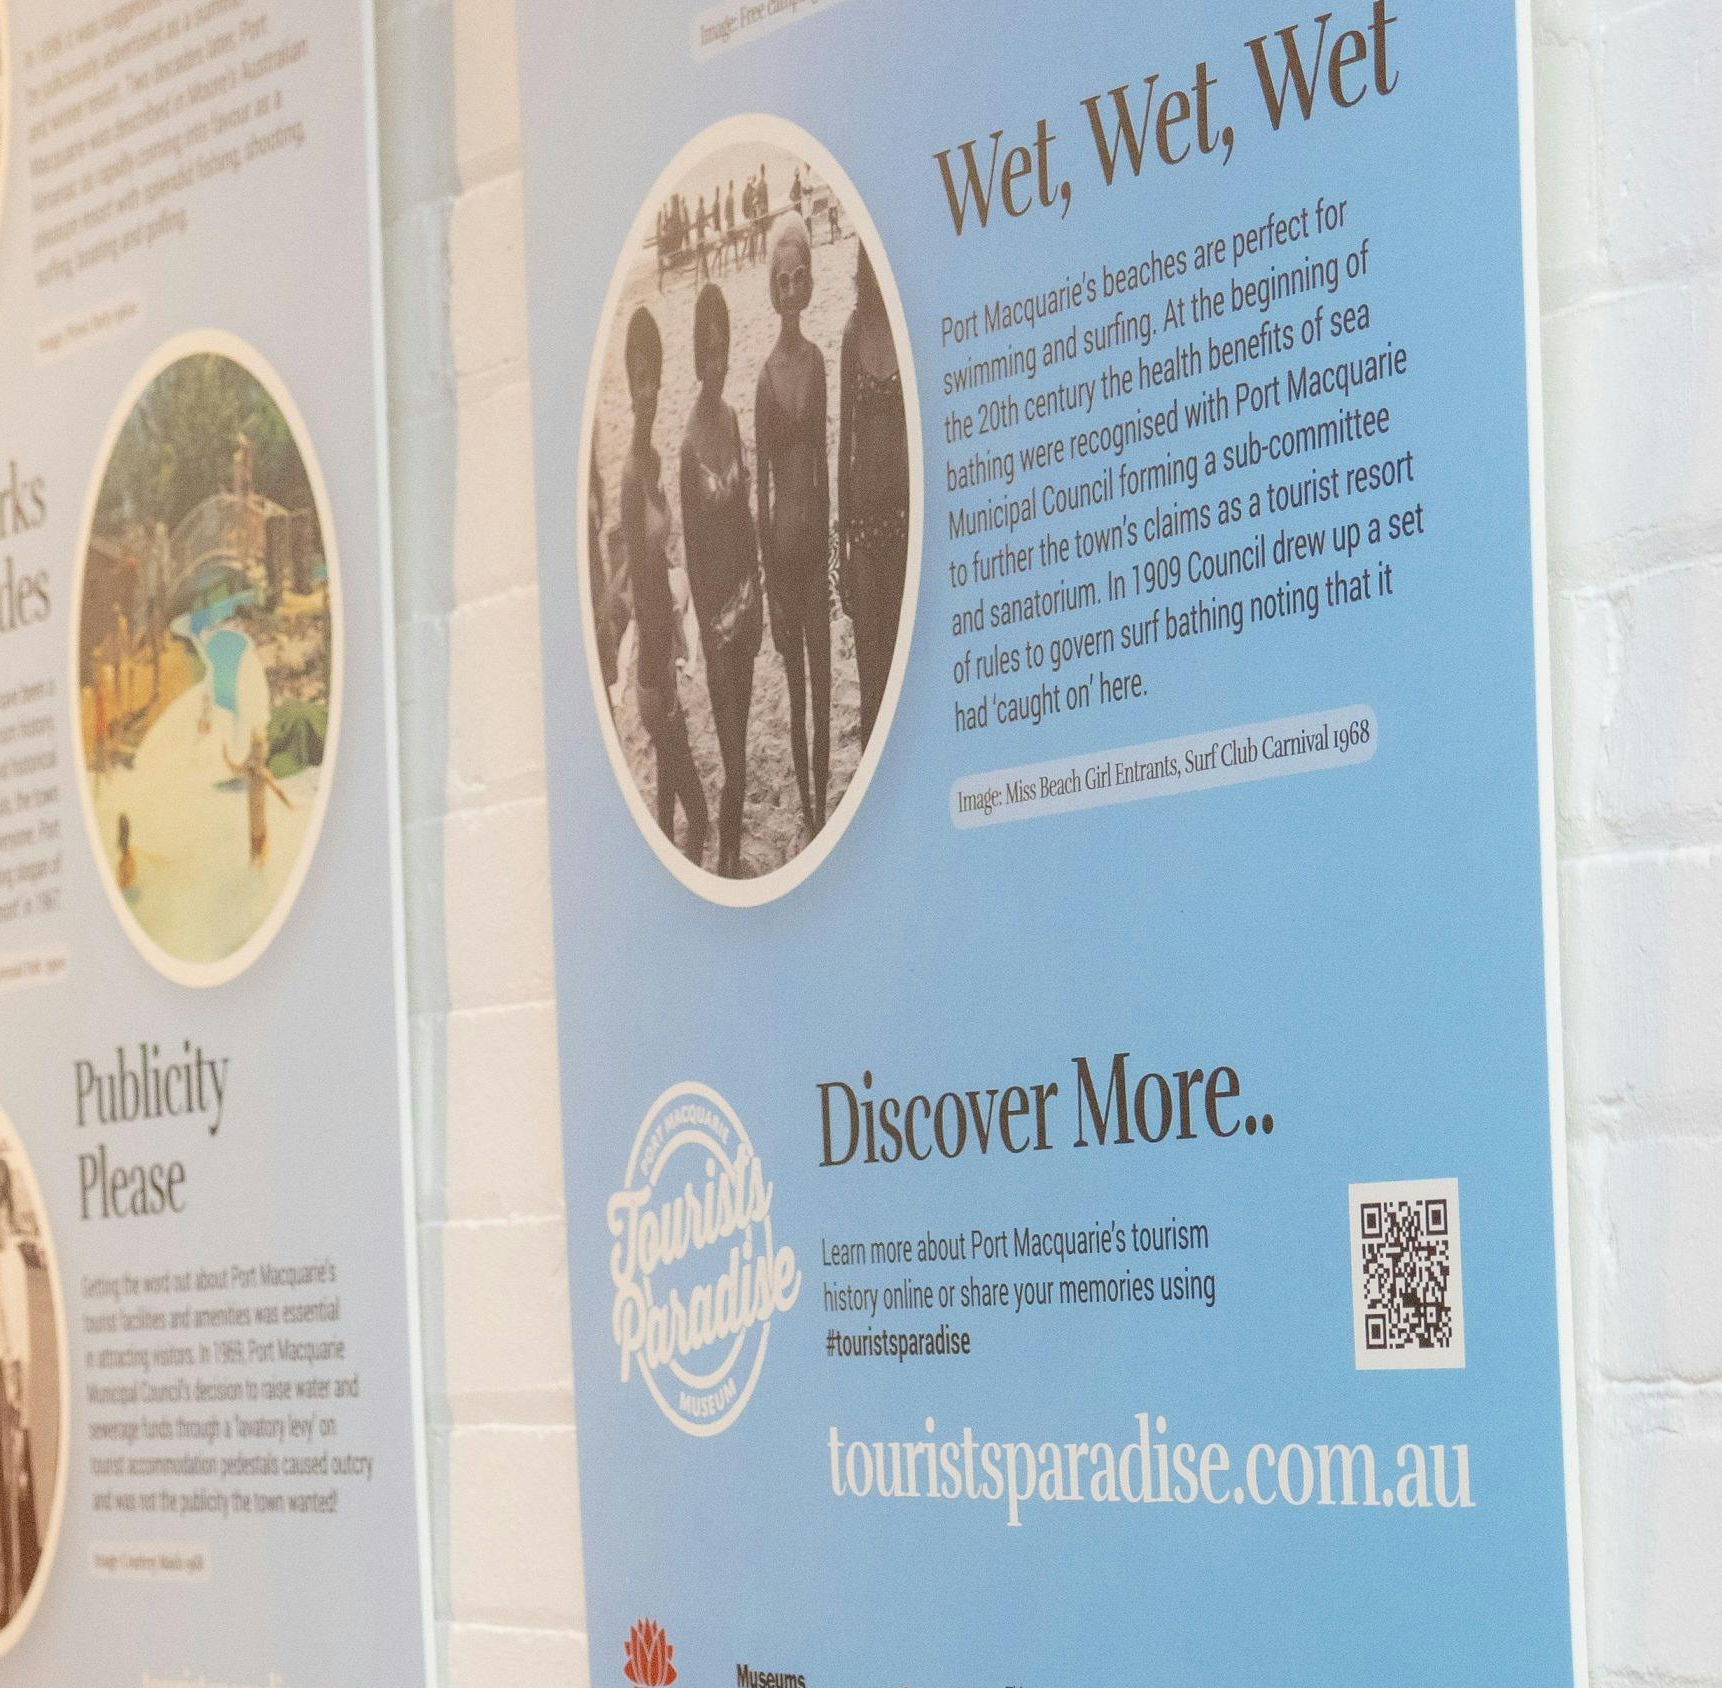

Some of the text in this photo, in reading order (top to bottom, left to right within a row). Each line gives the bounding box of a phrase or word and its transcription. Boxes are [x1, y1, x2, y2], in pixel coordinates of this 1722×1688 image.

[933, 0, 1400, 237] Wet, Wet, Wet
[942, 313, 978, 344] Port
[1103, 251, 1187, 297] beaches
[1194, 239, 1225, 270] are
[1233, 208, 1309, 267] perfect
[1315, 197, 1347, 233] for
[944, 238, 1369, 395] swimming and surfing. At the beginning of
[945, 304, 1369, 443] the 20th century the health benefits of sea
[947, 342, 1407, 491] bathing were recognised with Port Macquarie
[949, 408, 1389, 539] Municipal Council forming a sub-committee
[953, 504, 1424, 636] and sanatorium. In 1909 Council drew up a set
[955, 696, 987, 732] had
[1100, 671, 1147, 703] here.
[959, 719, 1370, 815] Image: Miss Beach Girl Entrants, Surf Club Carnival 1968
[74, 1038, 231, 1137] Publicity
[665, 1103, 730, 1145] MACQUARIE
[817, 1051, 1275, 1167] Discover More..
[77, 1144, 188, 1221] Please
[607, 1142, 773, 1291] Tourists
[194, 1268, 229, 1291] about
[231, 1264, 258, 1288] Port
[822, 1239, 865, 1266] Learn
[871, 1241, 912, 1263] more
[918, 1231, 966, 1262] about
[971, 1230, 1008, 1259] Port
[1131, 1217, 1208, 1252] tourism
[824, 1269, 1215, 1318] history online or share your memories using
[612, 1246, 802, 1384] Paradise
[826, 1324, 970, 1363] #touristsparadise
[679, 1378, 738, 1418] MUSEUM
[829, 1413, 1476, 1527] touristsparadise.com.au
